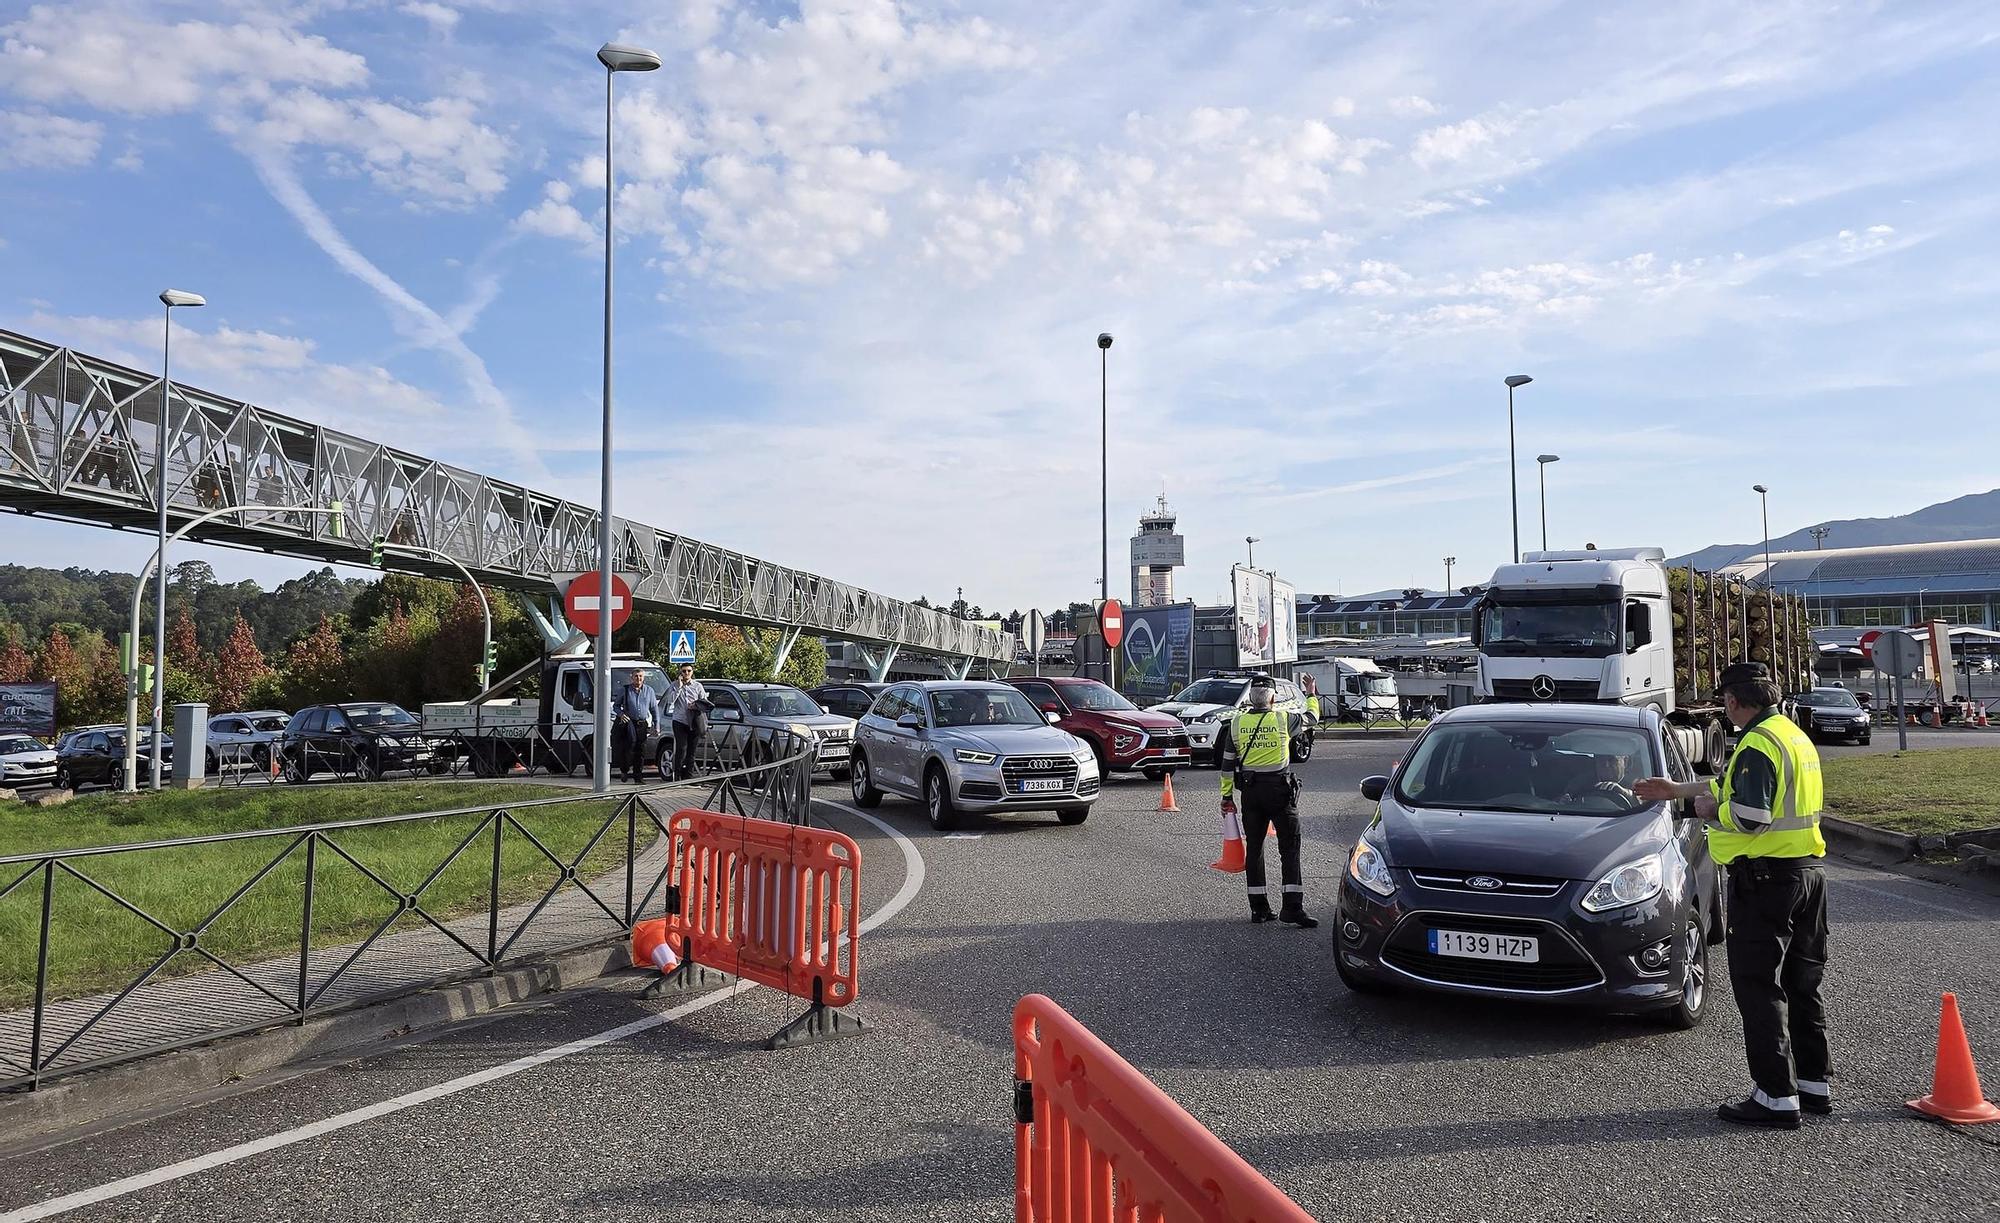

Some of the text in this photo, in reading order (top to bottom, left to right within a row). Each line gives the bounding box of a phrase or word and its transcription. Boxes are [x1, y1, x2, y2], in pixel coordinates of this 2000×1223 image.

[1025, 781, 1061, 790] 7336 KGX
[1473, 878, 1494, 888] Ford
[1445, 933, 1489, 953] 1139
[1496, 938, 1533, 957] HZP
